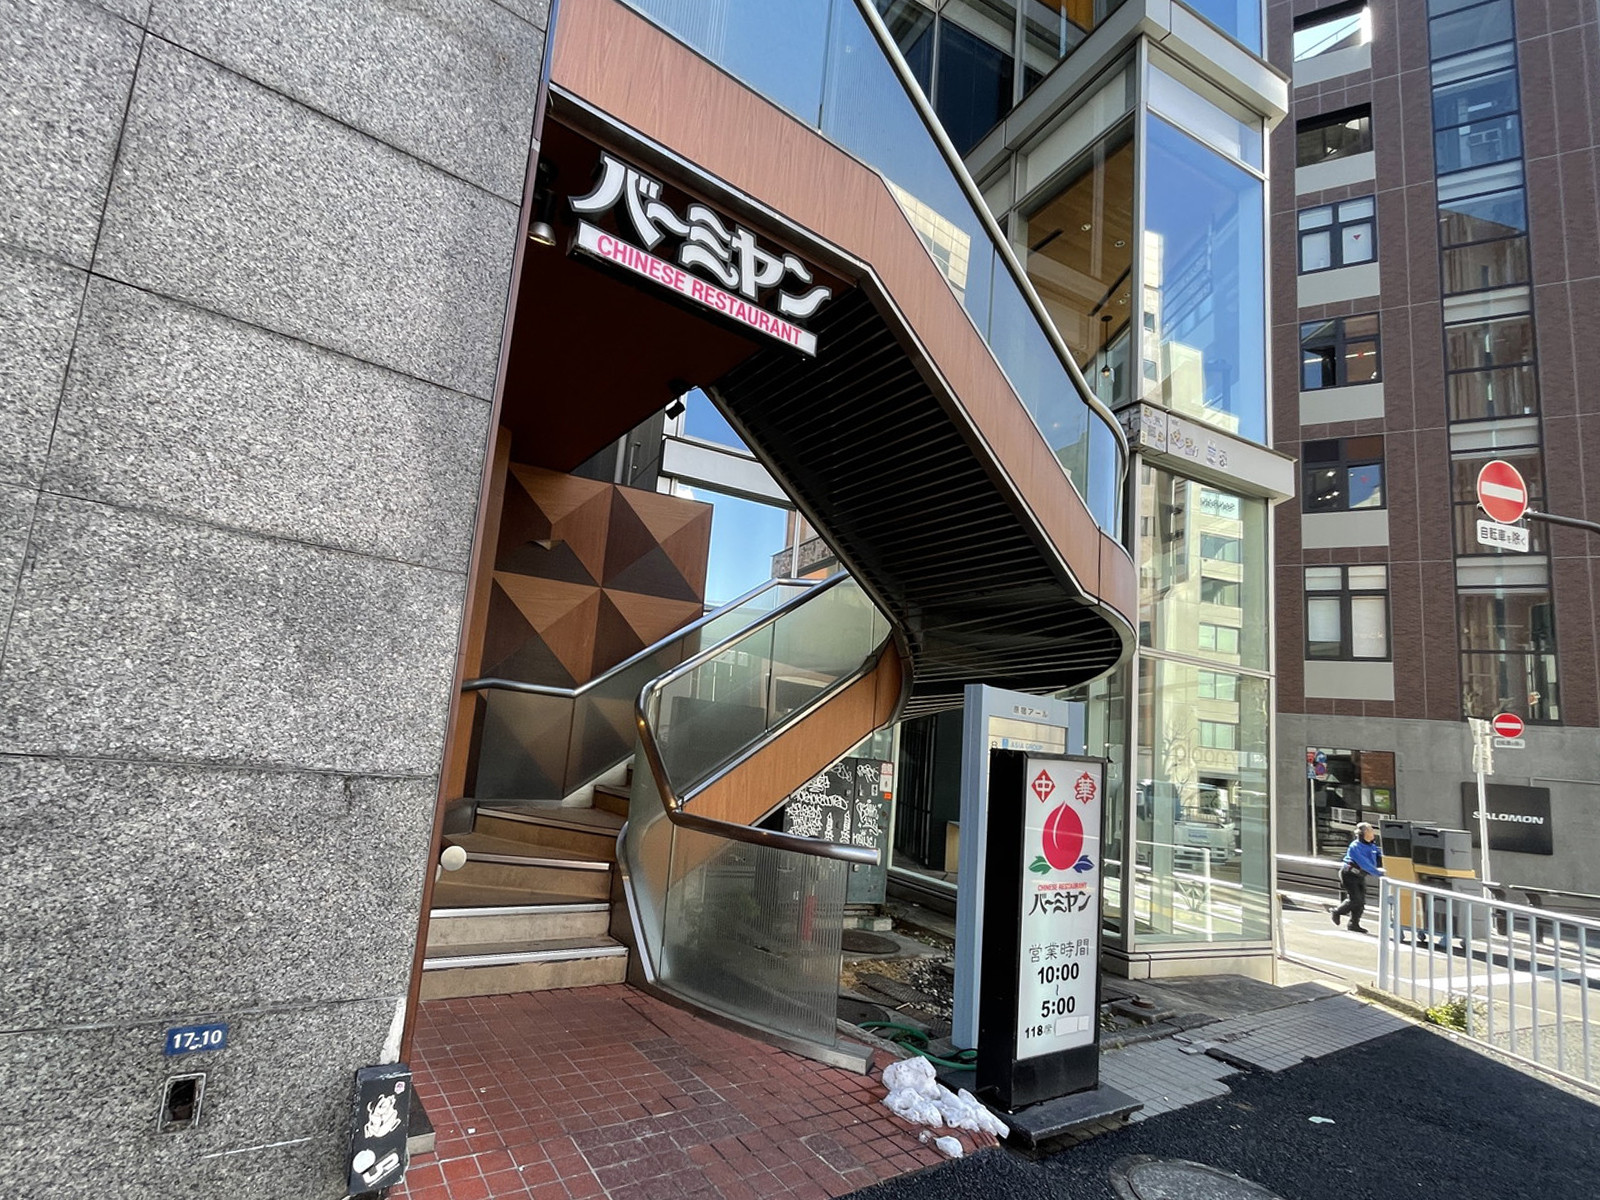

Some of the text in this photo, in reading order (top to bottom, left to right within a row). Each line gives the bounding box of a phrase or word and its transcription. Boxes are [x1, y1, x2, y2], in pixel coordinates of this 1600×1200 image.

[569, 152, 831, 317] バーミヤン
[597, 235, 802, 345] CHINESE RESTAURANT
[1480, 525, 1526, 546] 自転車を除く
[1472, 811, 1544, 824] SALOMON
[1038, 882, 1087, 892] CHINESE RESTAURANT
[1028, 890, 1092, 916] バーミヤン
[1029, 938, 1090, 963] 営業時間
[1037, 962, 1080, 984] 10:00
[1041, 995, 1076, 1018] 5:00
[173, 1029, 222, 1049] 17-10
